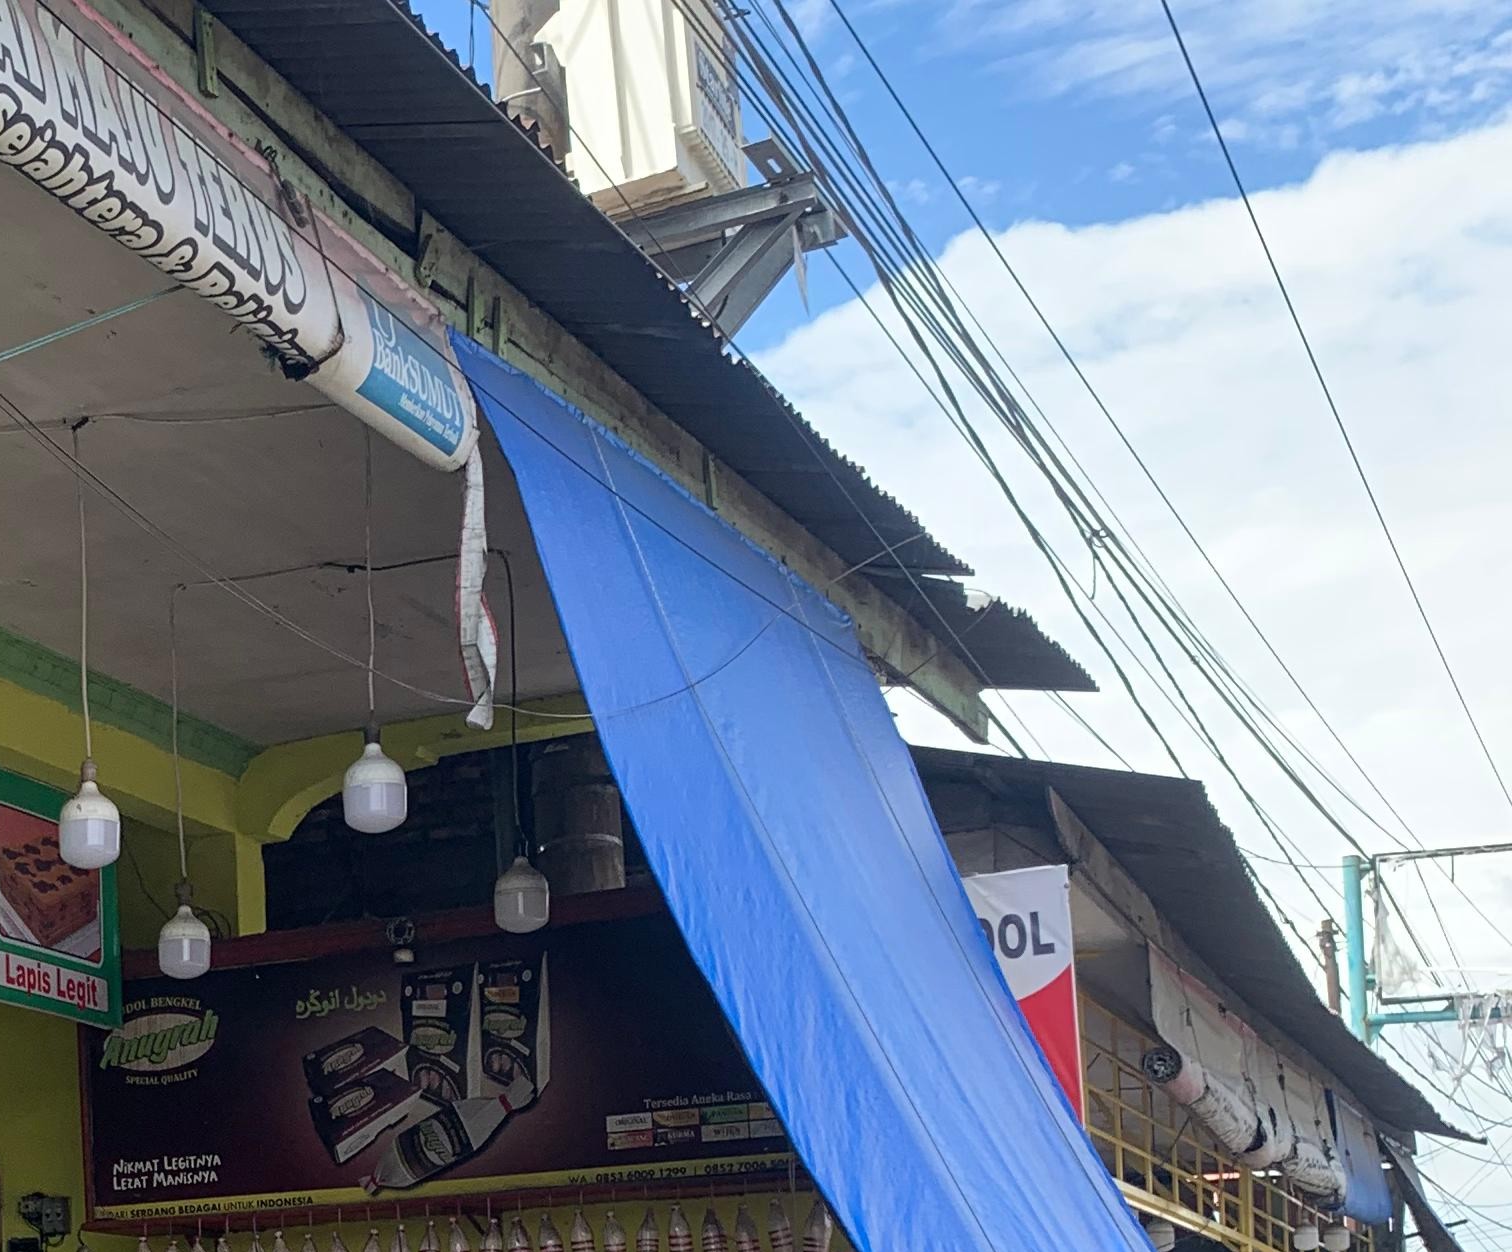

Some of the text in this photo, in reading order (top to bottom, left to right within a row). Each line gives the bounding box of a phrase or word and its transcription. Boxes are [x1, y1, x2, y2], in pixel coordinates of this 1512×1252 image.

[34, 3, 175, 205] MAJU
[5, 954, 97, 1010] Lapis Legit
[99, 1008, 219, 1071] Anugrah
[113, 1174, 148, 1191] LEZAT
[130, 1206, 176, 1218] SERDANG
[178, 1203, 221, 1215] BEDAGAI
[223, 1200, 255, 1212] UNTUK
[256, 1196, 313, 1208] INDONESIA
